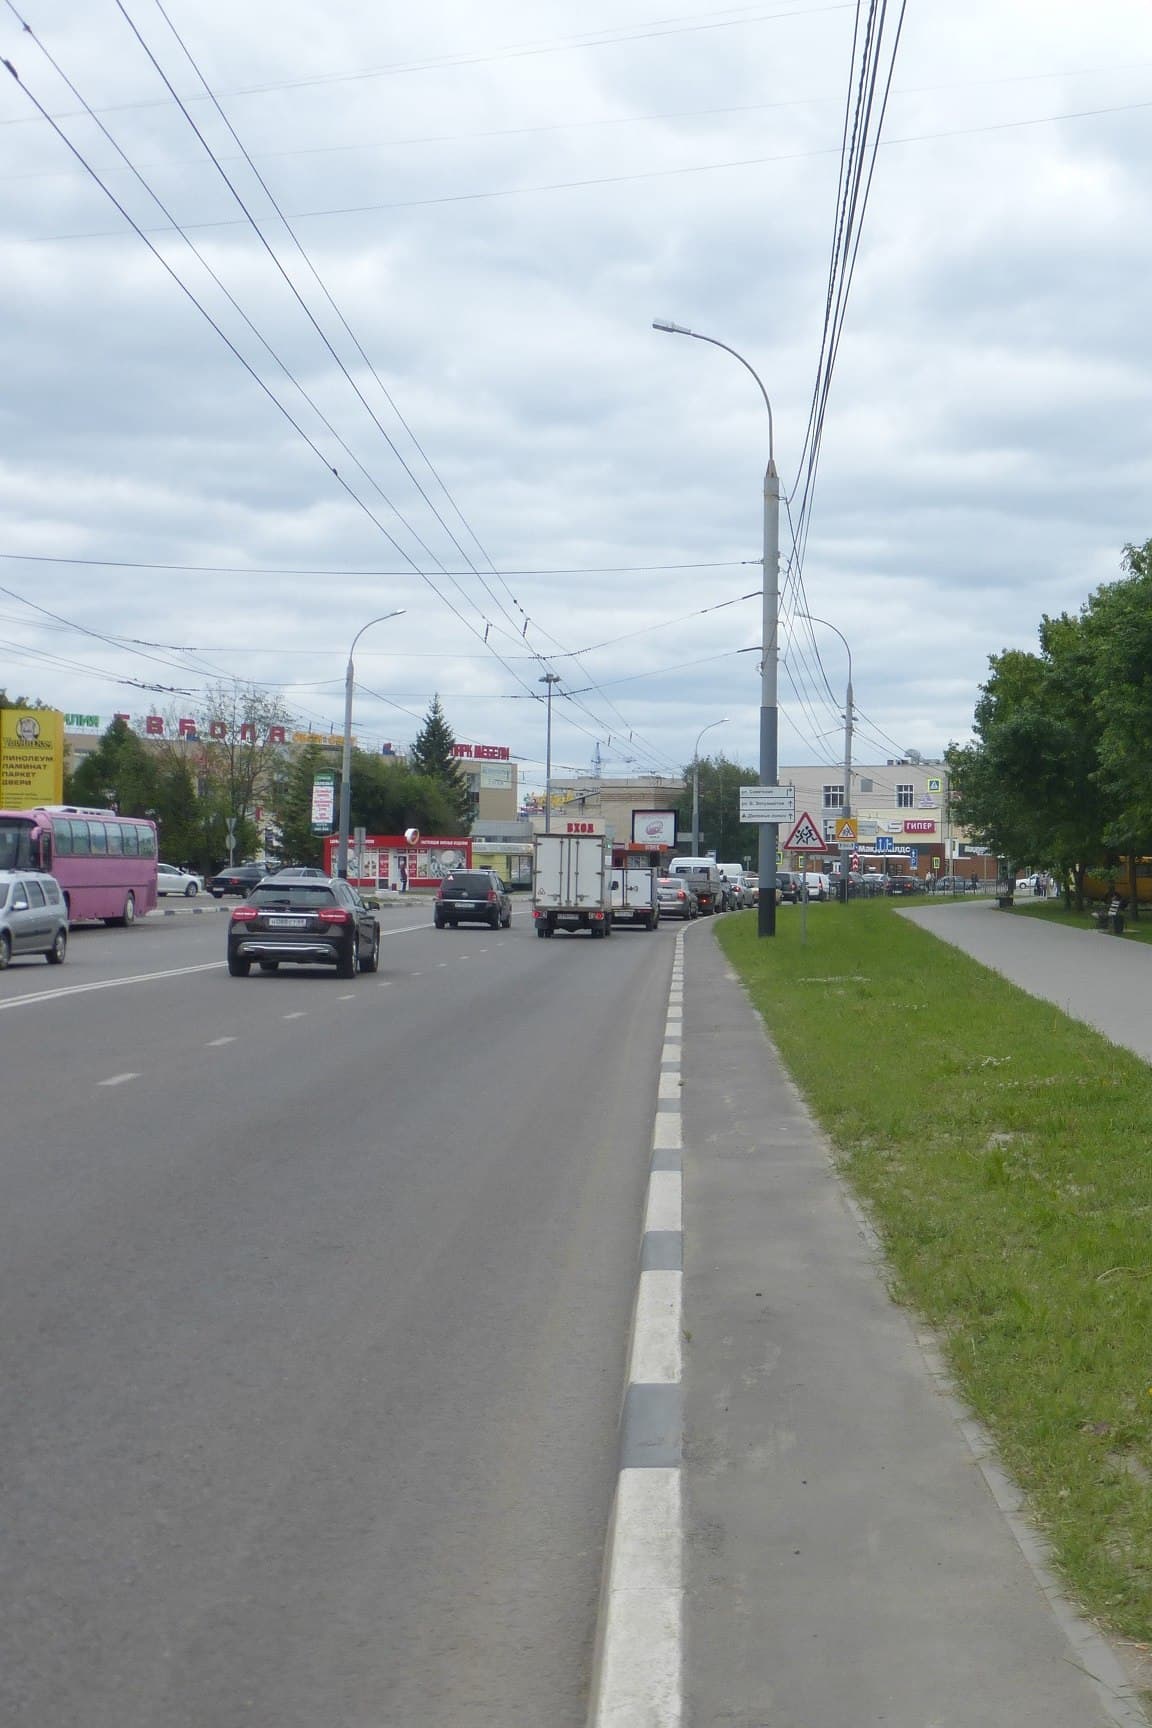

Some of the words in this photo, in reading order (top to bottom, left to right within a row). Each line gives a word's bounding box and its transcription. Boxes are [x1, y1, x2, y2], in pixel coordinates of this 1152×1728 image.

[114, 713, 285, 745] ВРОПА
[567, 822, 595, 833] ВХОД
[906, 821, 933, 830] ГИПЕР
